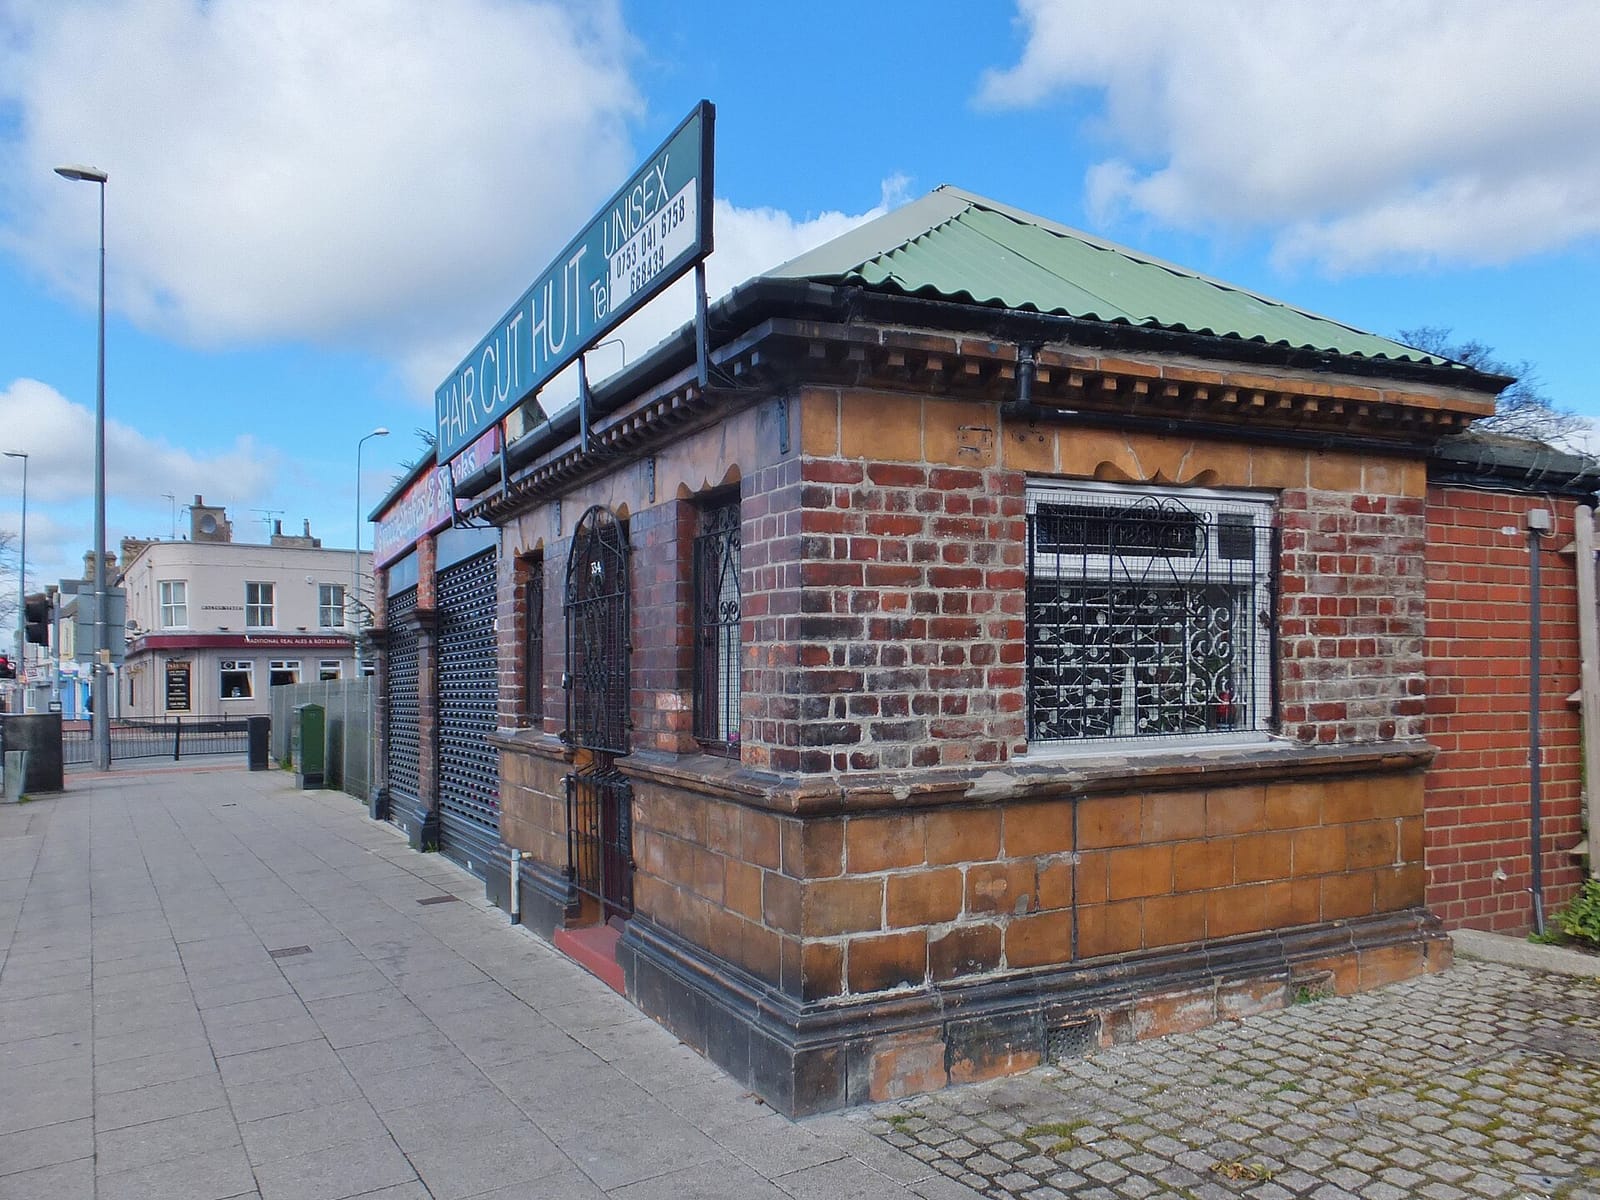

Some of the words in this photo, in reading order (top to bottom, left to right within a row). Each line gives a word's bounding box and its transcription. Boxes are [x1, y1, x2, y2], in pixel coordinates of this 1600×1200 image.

[603, 154, 670, 260] UNISEX
[616, 241, 637, 279] 0753
[641, 222, 656, 257] 041
[661, 195, 685, 239] 6758
[531, 244, 587, 373] HUT
[630, 244, 664, 296] 668439
